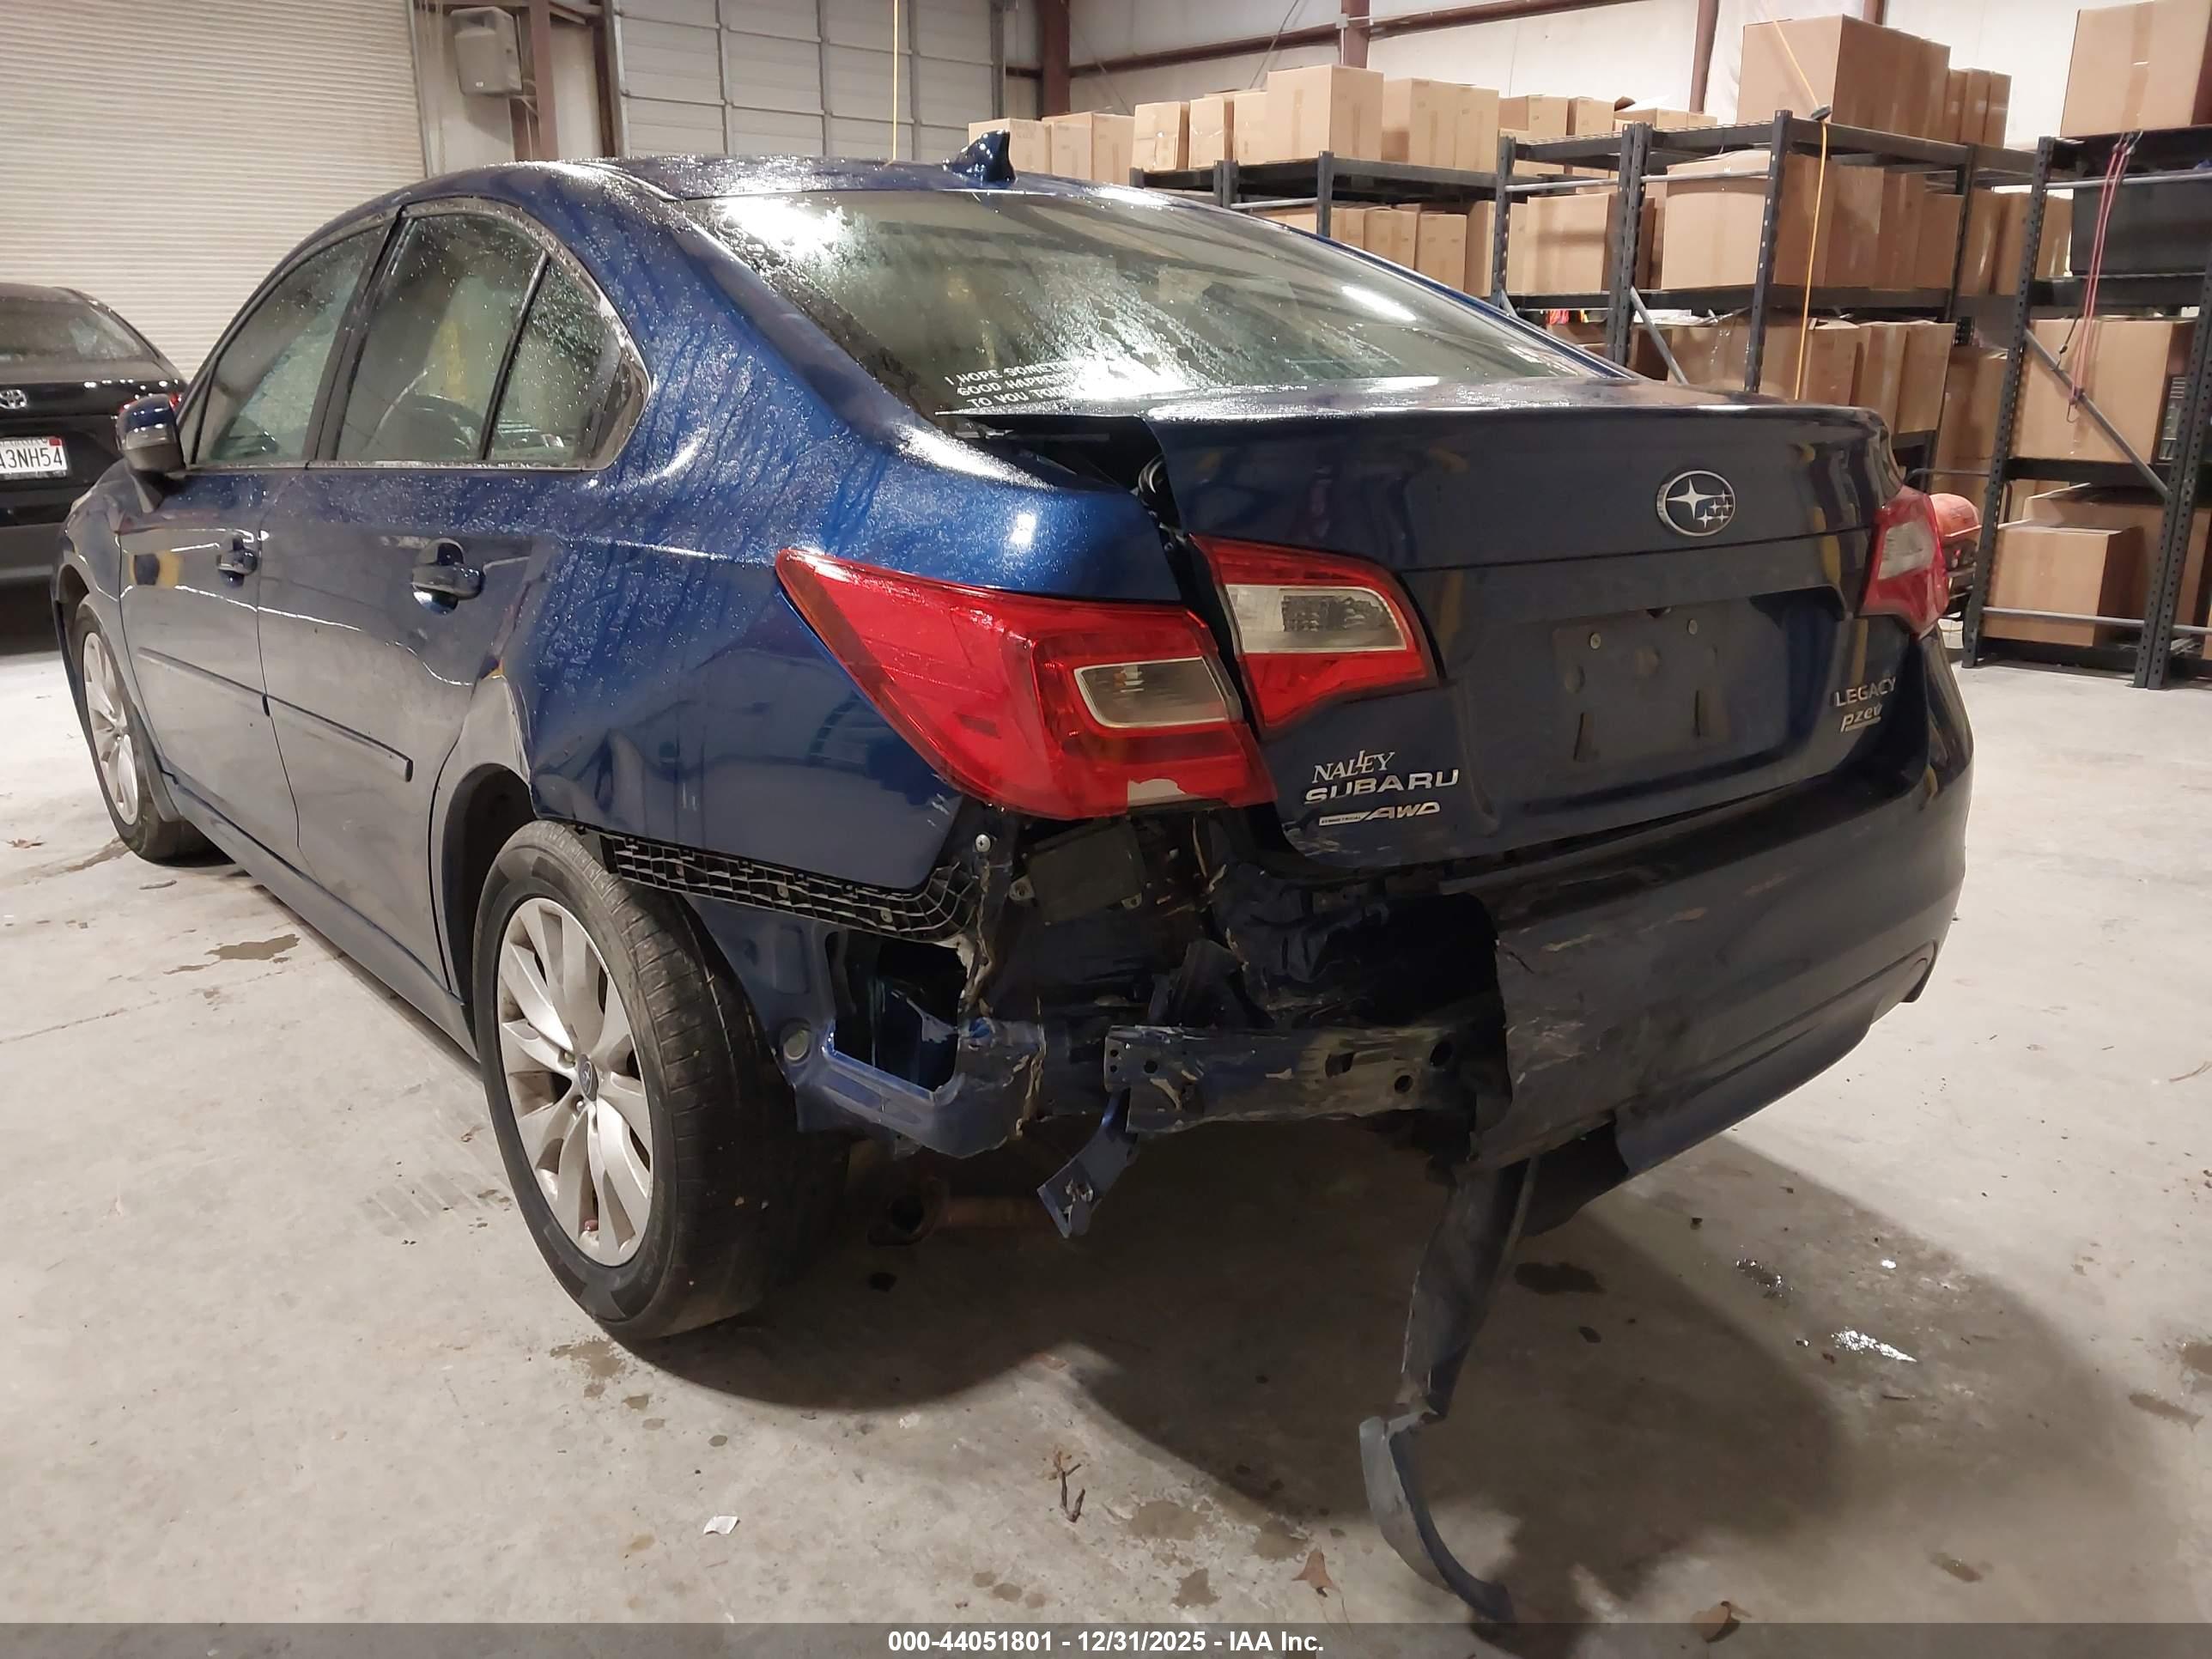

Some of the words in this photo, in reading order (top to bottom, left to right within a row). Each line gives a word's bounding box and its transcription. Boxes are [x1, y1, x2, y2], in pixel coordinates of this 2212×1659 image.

[945, 376, 954, 386] I
[957, 369, 1003, 384] HOPE
[1004, 362, 1072, 378] SOMET
[957, 382, 1002, 396] GOOD
[967, 397, 993, 408] TO
[994, 392, 1030, 404] YOU
[1835, 676, 1896, 707] LEGACY
[1311, 750, 1395, 784] NALLEY
[1304, 769, 1460, 805] SUBARU
[1364, 800, 1441, 821] AWD
